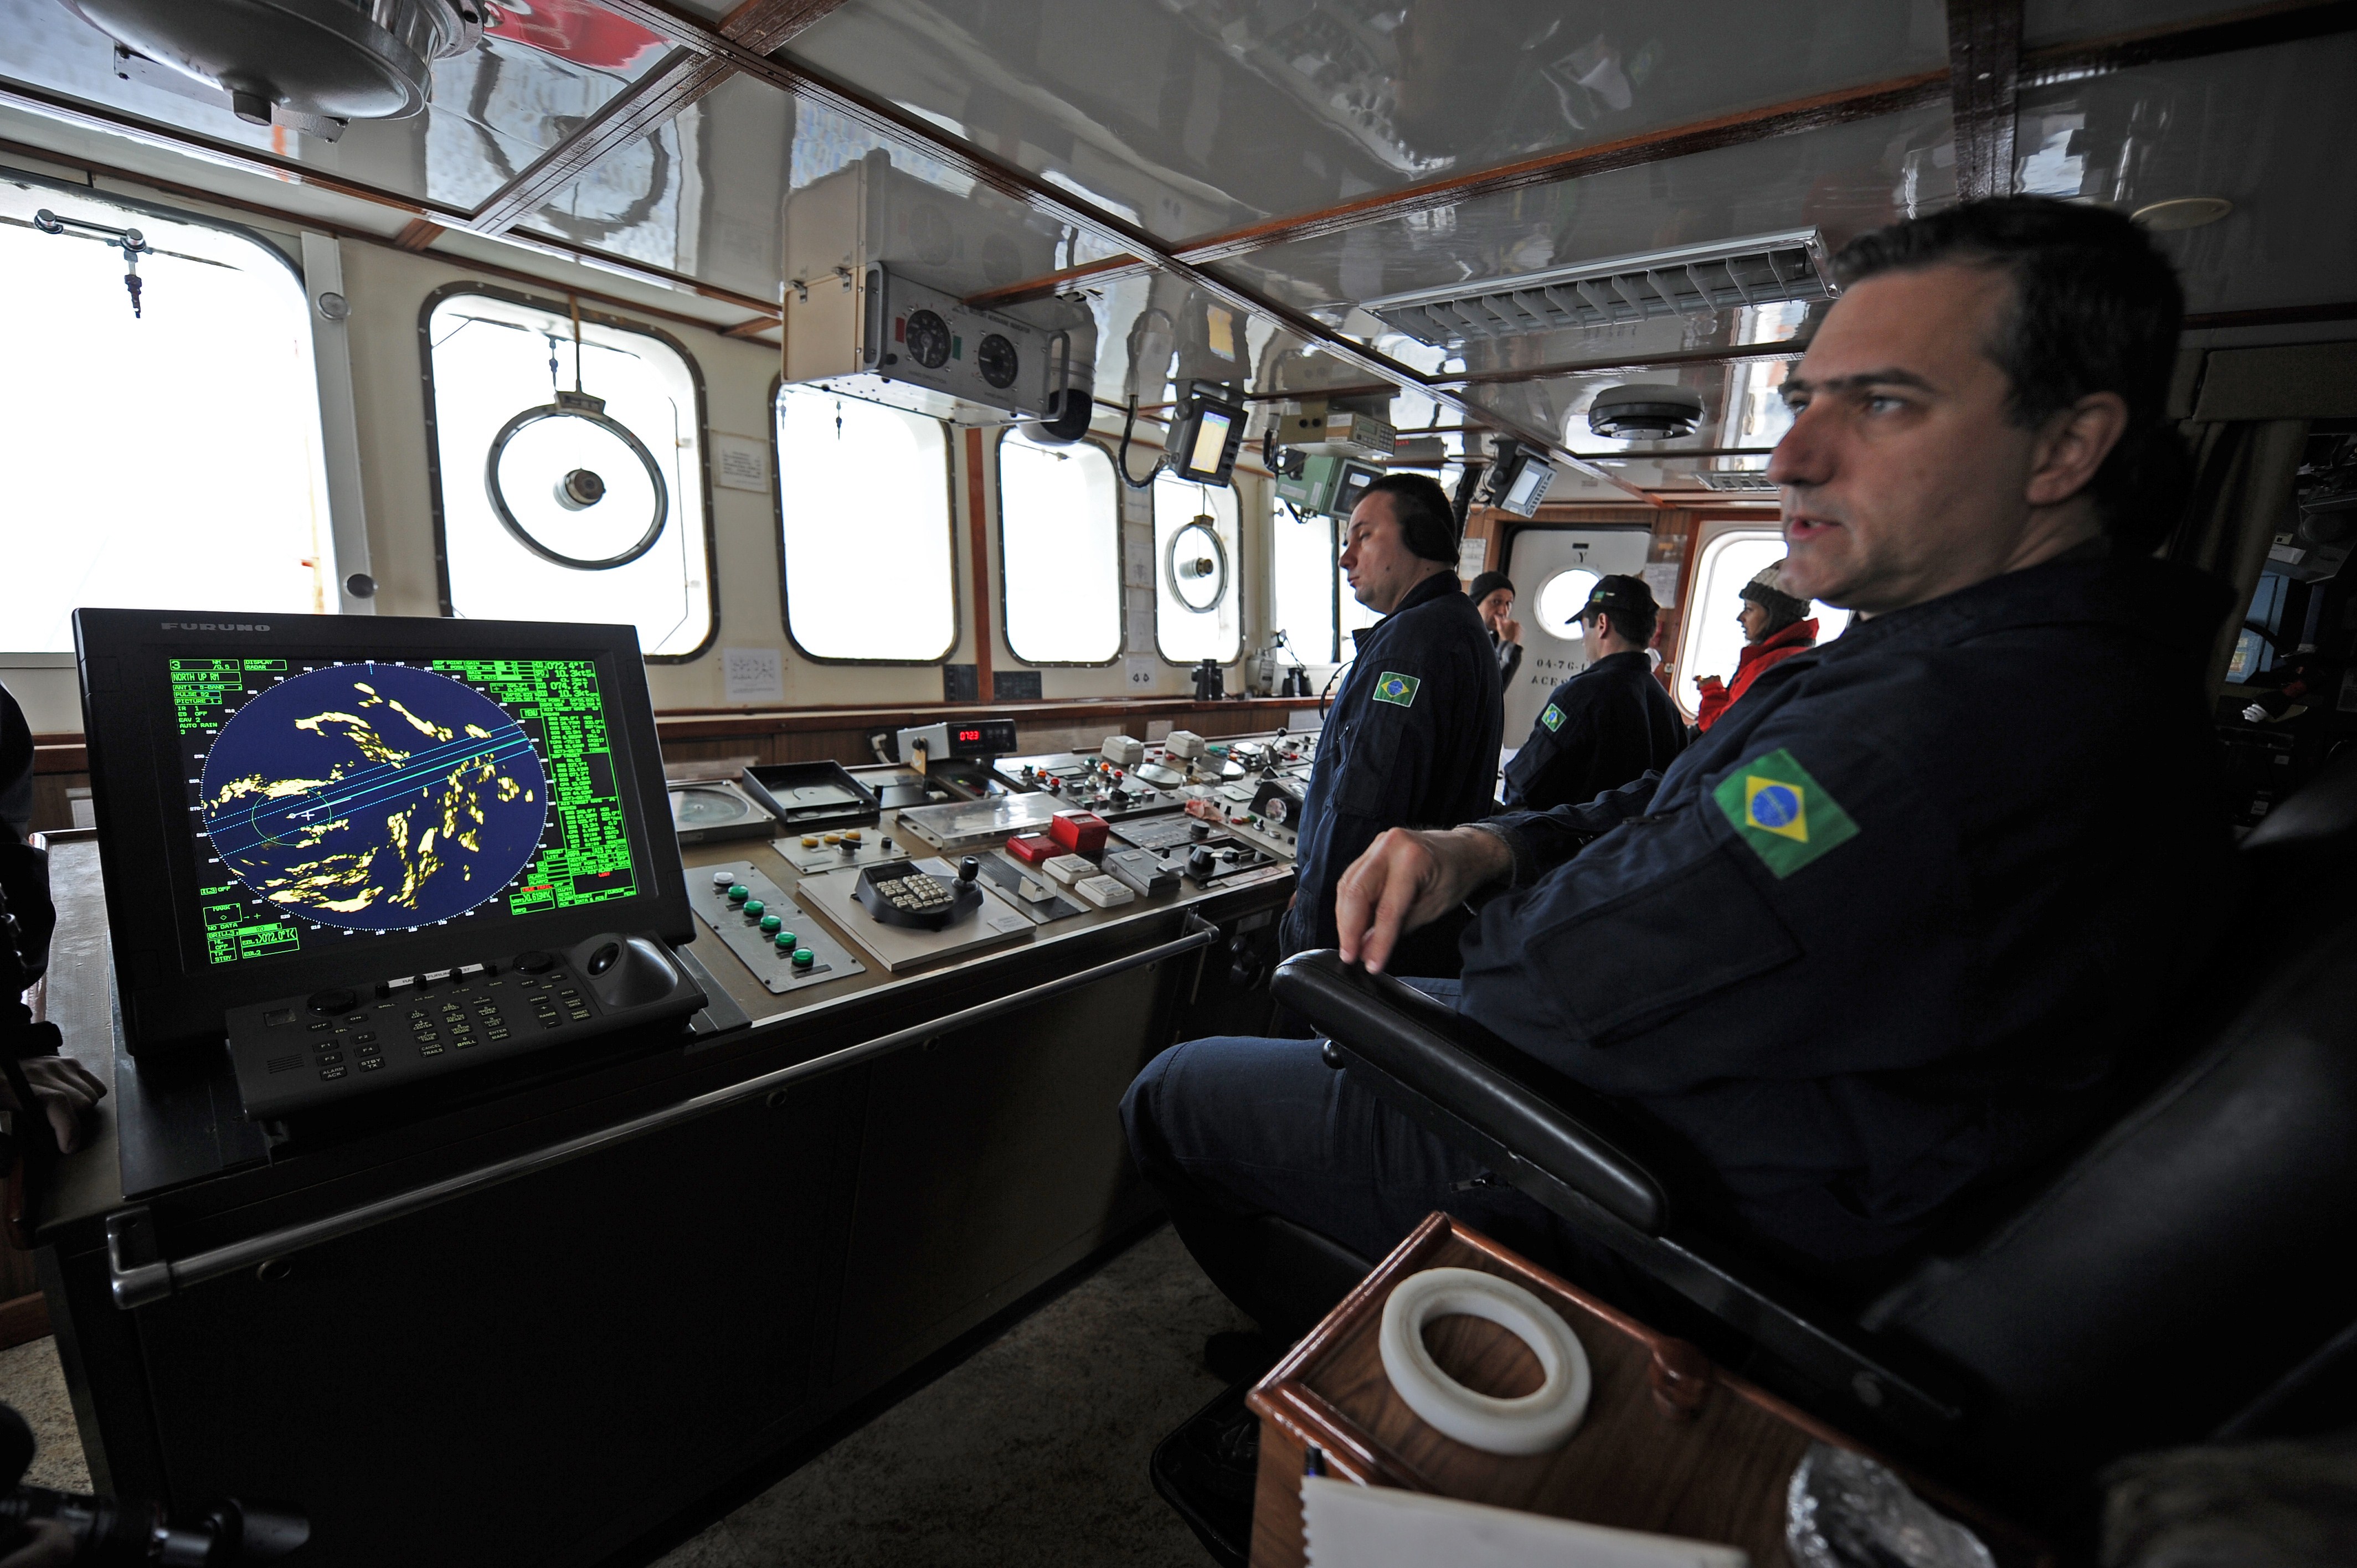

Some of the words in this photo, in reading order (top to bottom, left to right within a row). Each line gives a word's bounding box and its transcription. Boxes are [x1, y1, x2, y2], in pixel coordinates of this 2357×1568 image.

[161, 623, 270, 631] FURUNO
[172, 660, 181, 669] 3
[173, 673, 194, 681] NORTH
[198, 673, 207, 681] UP
[361, 1058, 381, 1066] STBY
[322, 1066, 344, 1075] ALARM
